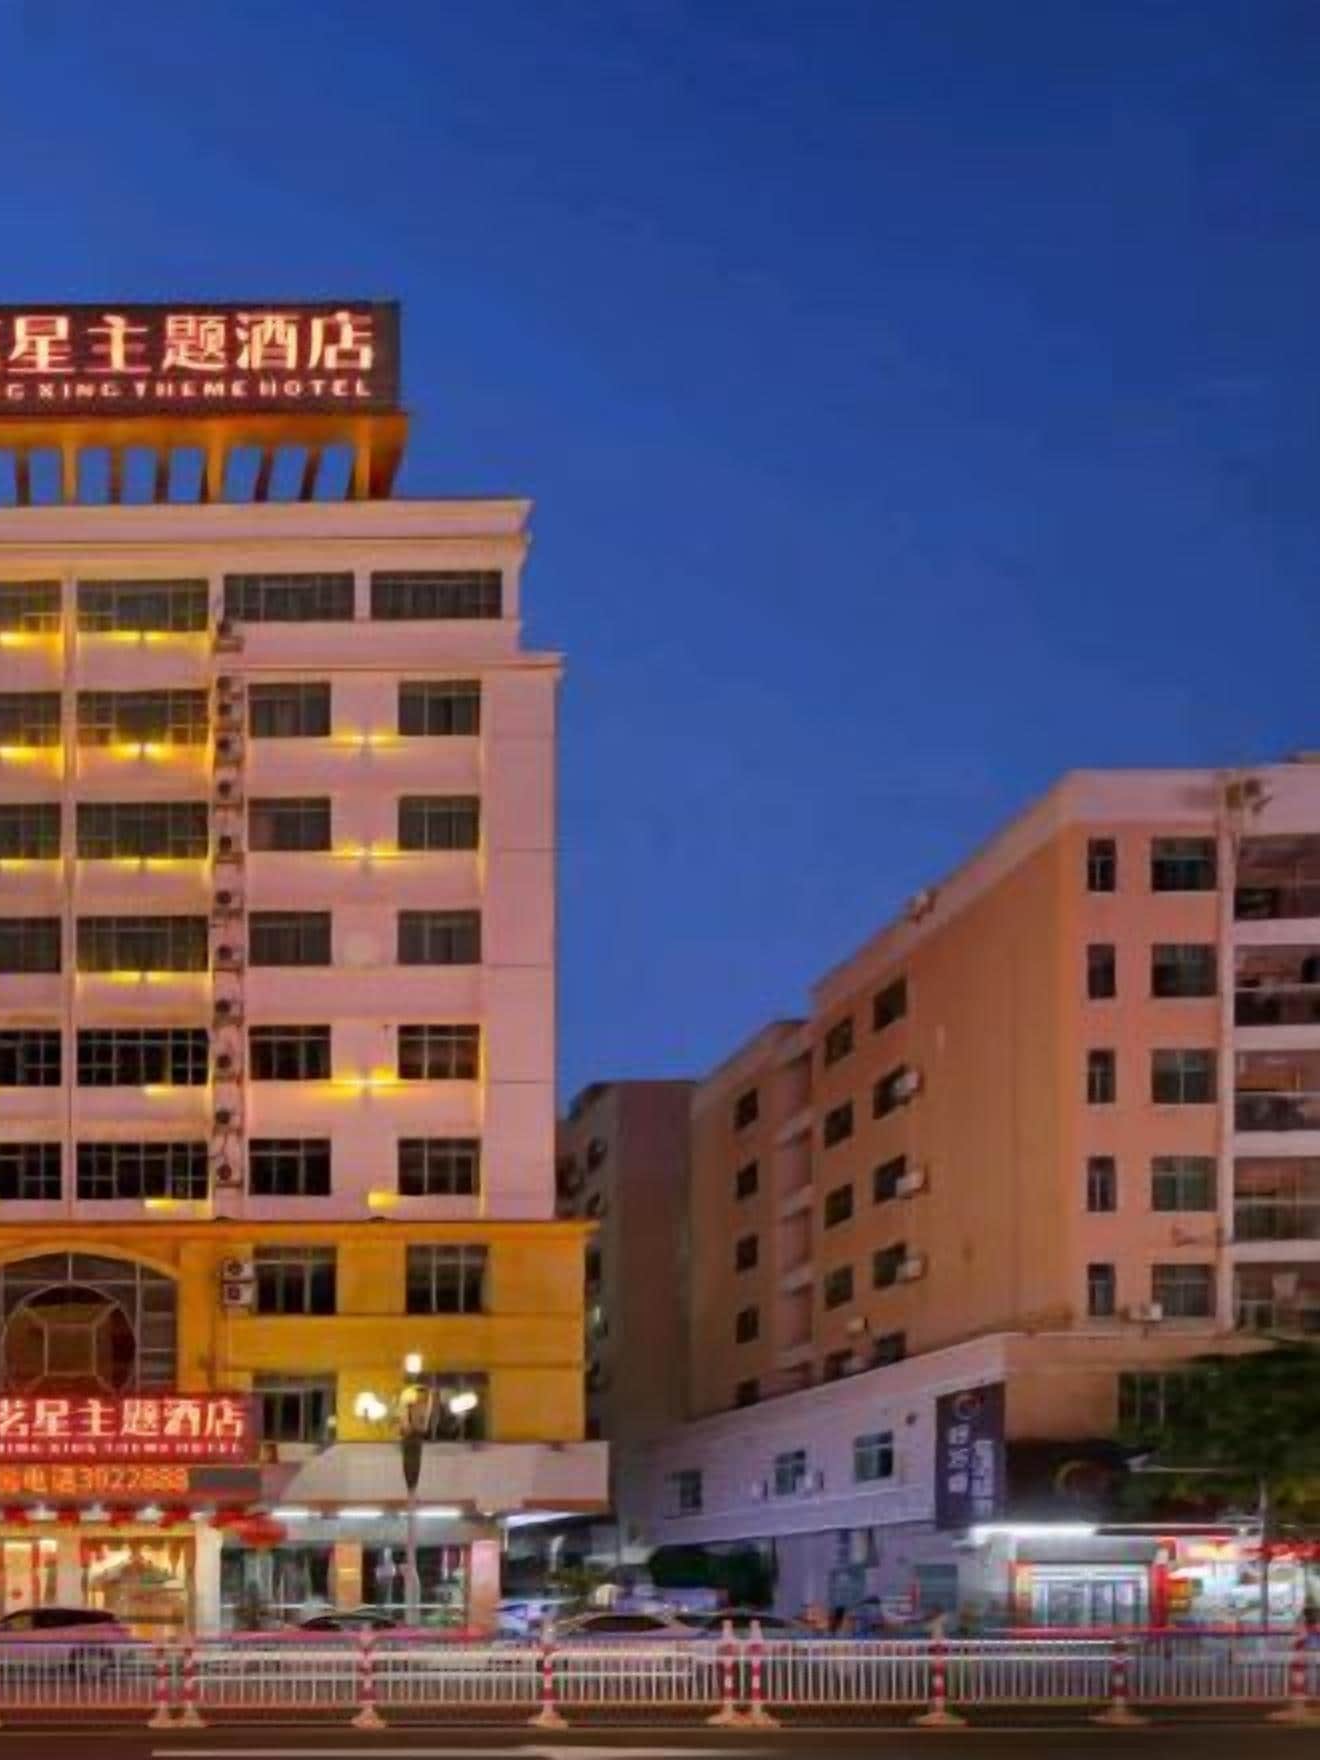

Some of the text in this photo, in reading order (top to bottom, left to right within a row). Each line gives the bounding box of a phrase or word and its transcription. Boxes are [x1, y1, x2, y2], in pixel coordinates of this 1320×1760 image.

[38, 382, 121, 399] XING
[134, 379, 247, 397] THEME
[258, 378, 371, 397] HOTEL
